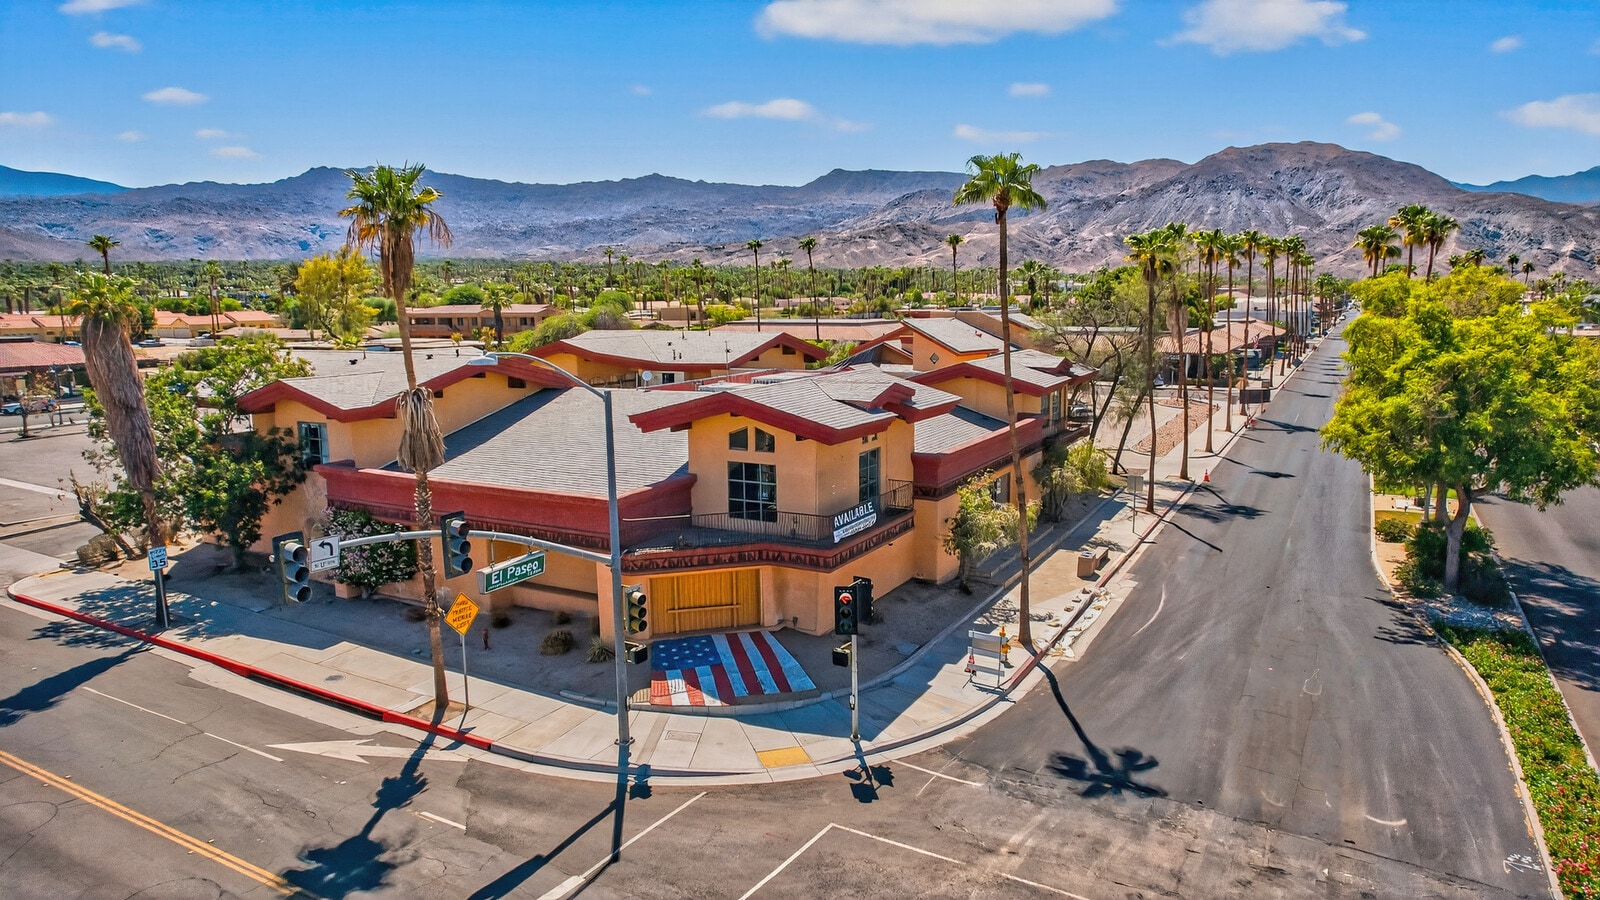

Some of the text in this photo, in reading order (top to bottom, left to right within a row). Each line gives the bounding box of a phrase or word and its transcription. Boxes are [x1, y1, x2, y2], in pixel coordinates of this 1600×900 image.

[834, 501, 874, 528] AVAILABLE
[151, 558, 166, 568] 35
[491, 570, 503, 585] El
[507, 560, 539, 579] Paseo
